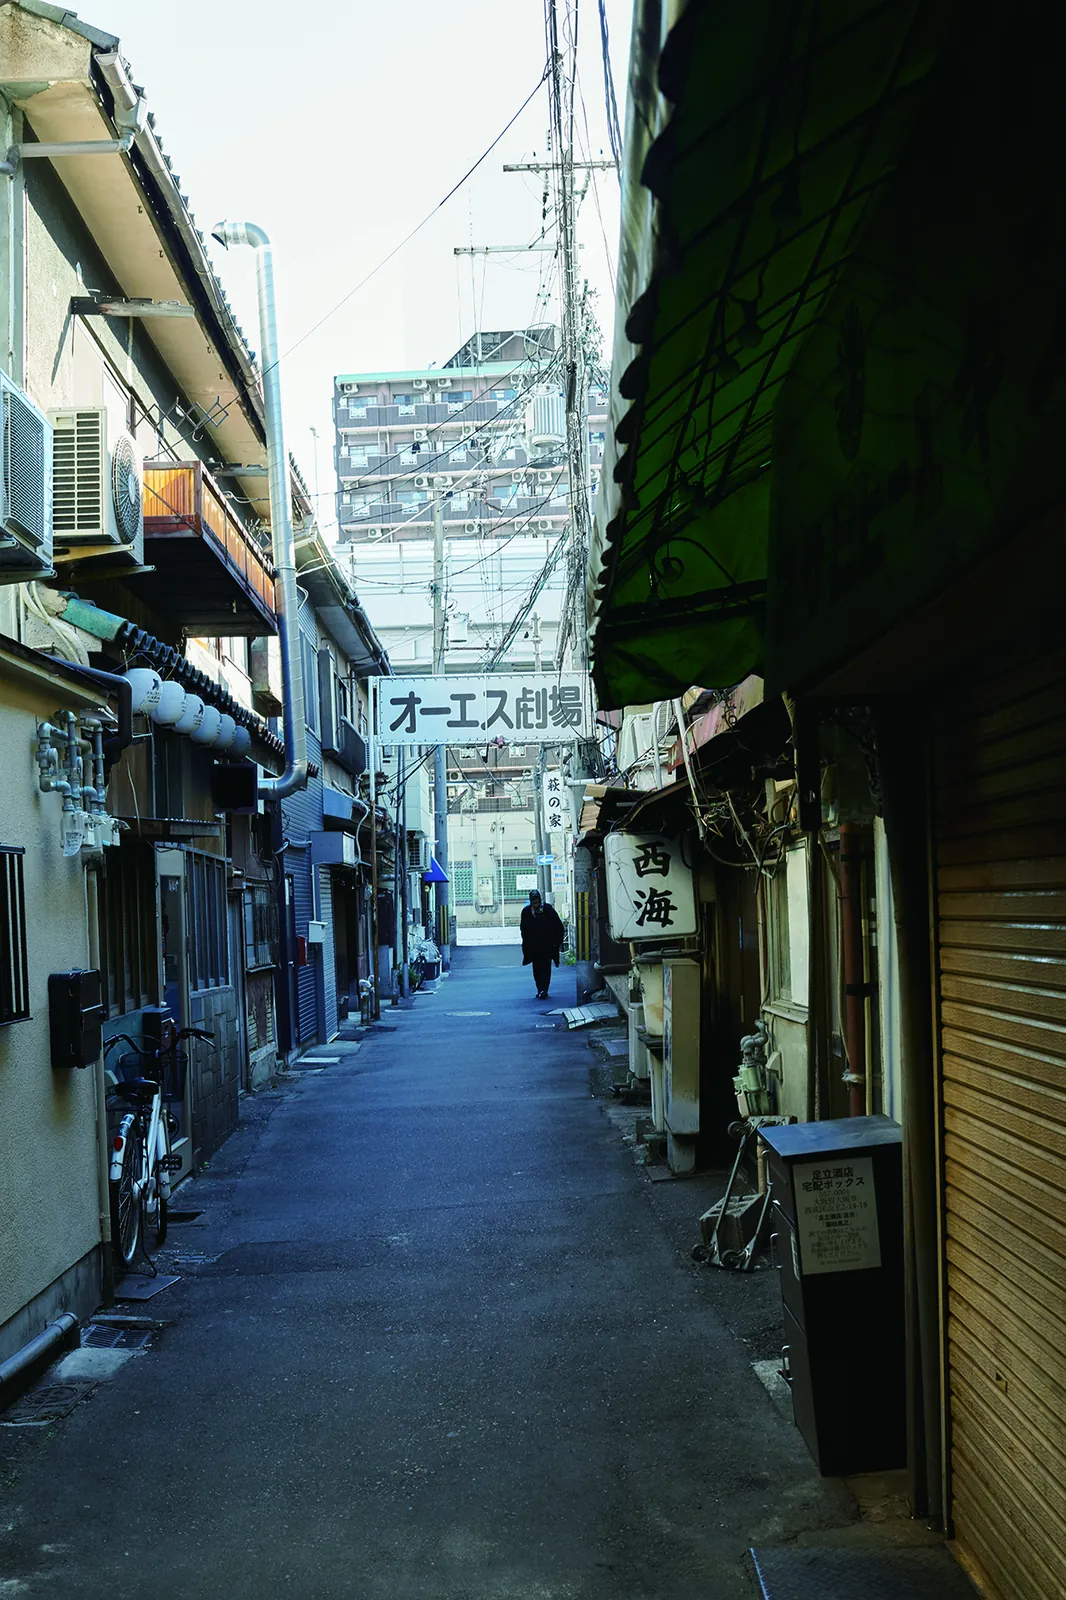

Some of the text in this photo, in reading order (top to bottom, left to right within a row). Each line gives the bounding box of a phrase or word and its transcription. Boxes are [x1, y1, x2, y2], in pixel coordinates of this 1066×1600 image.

[389, 685, 583, 734] オーエス劇場
[632, 841, 678, 928] 西海
[802, 1177, 865, 1192] 宅配ボックス
[812, 1166, 853, 1180] 足立酒店
